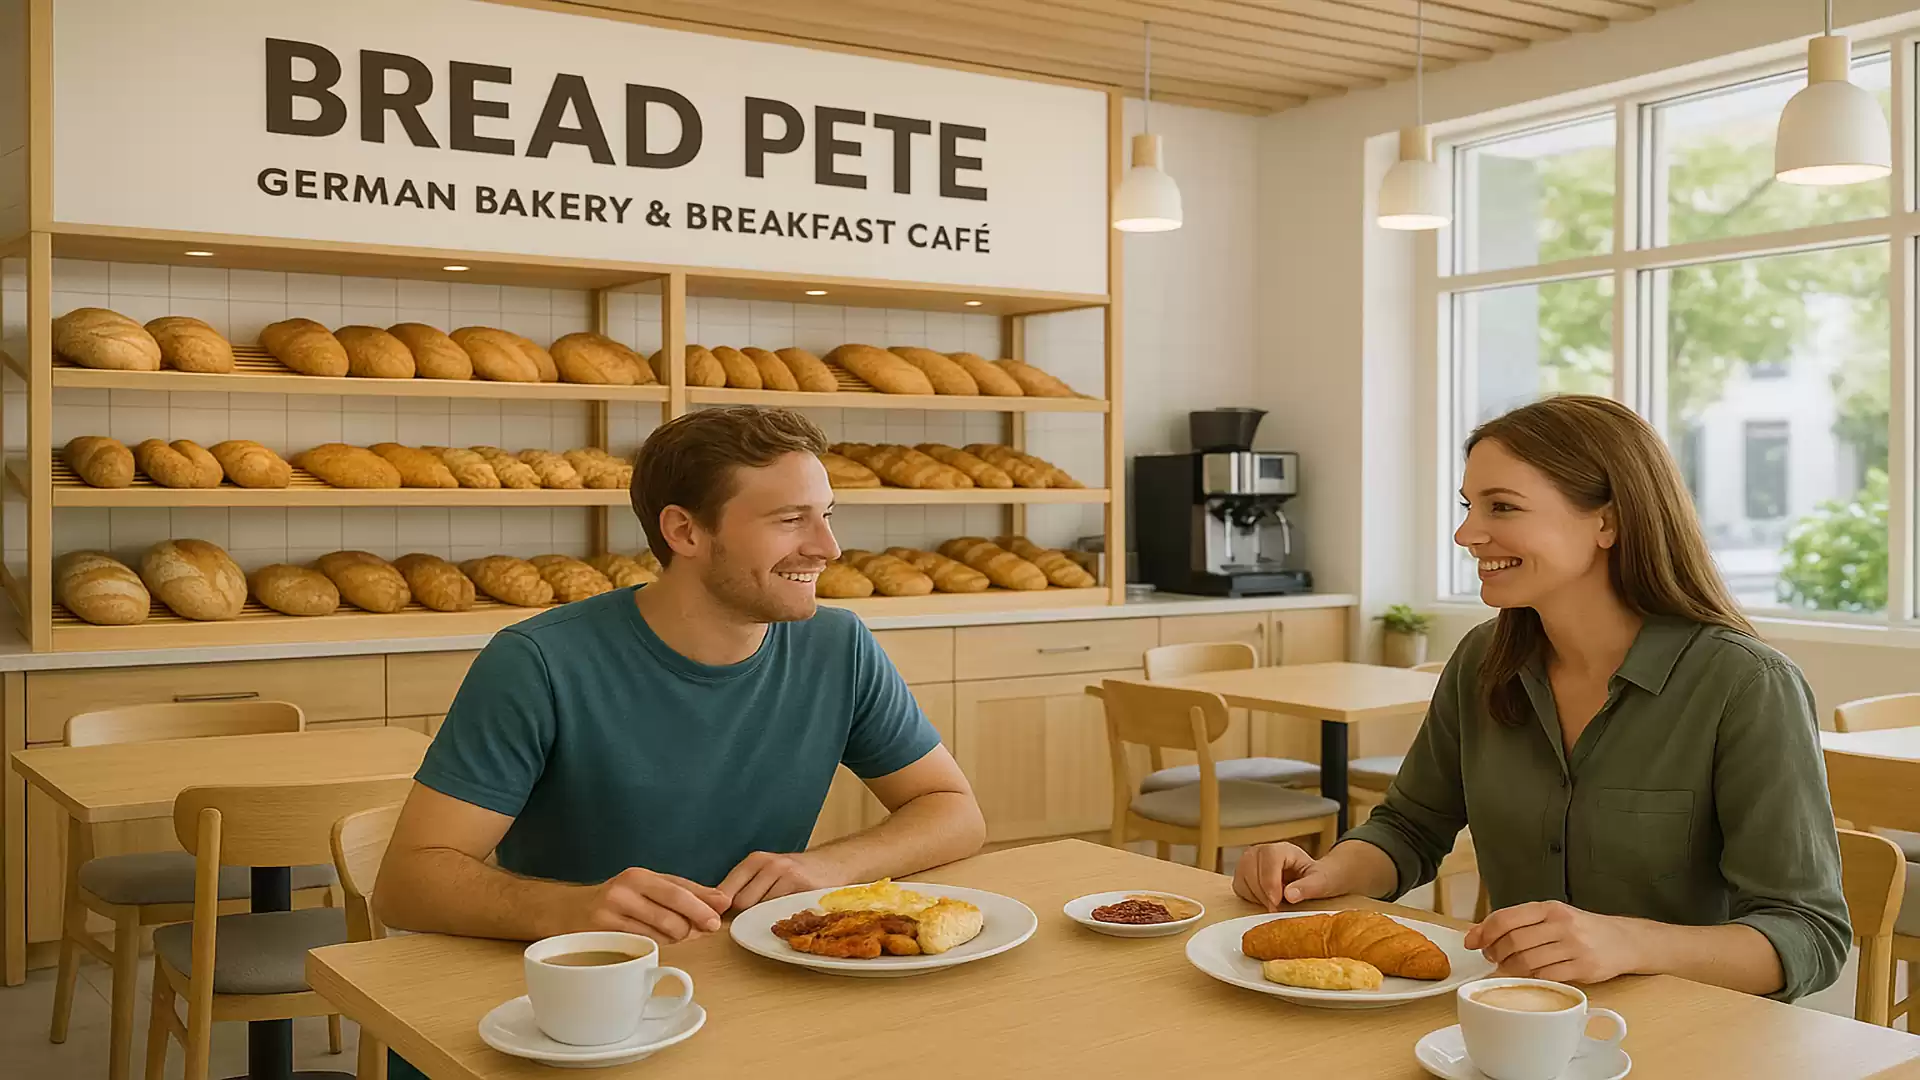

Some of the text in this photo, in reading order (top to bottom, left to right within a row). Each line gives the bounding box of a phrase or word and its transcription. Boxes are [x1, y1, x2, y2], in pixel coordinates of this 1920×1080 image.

[265, 38, 988, 202] BREAD PETE
[257, 167, 990, 254] GERMAN BAKERY & BREAKFAST CAFÉ
